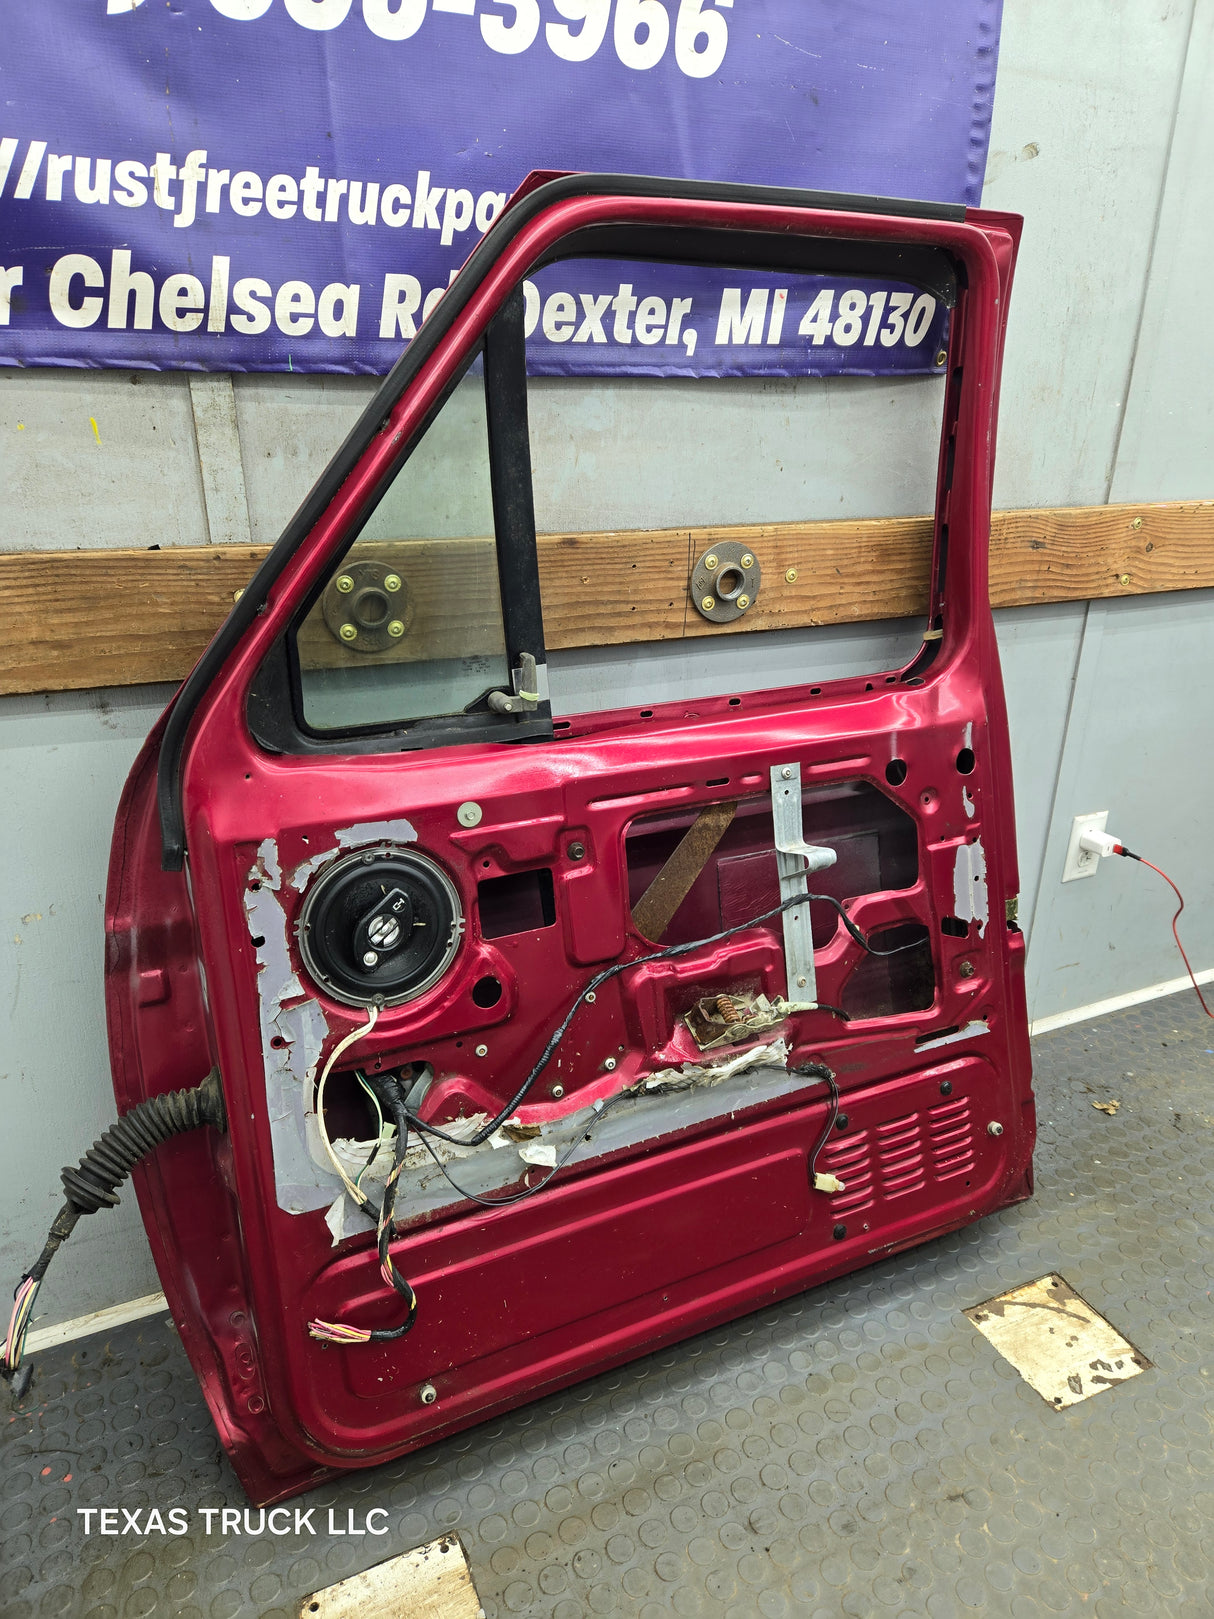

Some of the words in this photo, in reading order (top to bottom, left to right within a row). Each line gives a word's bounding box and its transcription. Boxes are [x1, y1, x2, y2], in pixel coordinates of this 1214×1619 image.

[0, 138, 513, 246] //rustfreetruckpa
[49, 250, 359, 337] Chelsea
[379, 270, 460, 339] R
[714, 287, 784, 345] MI
[799, 289, 936, 347] 48130
